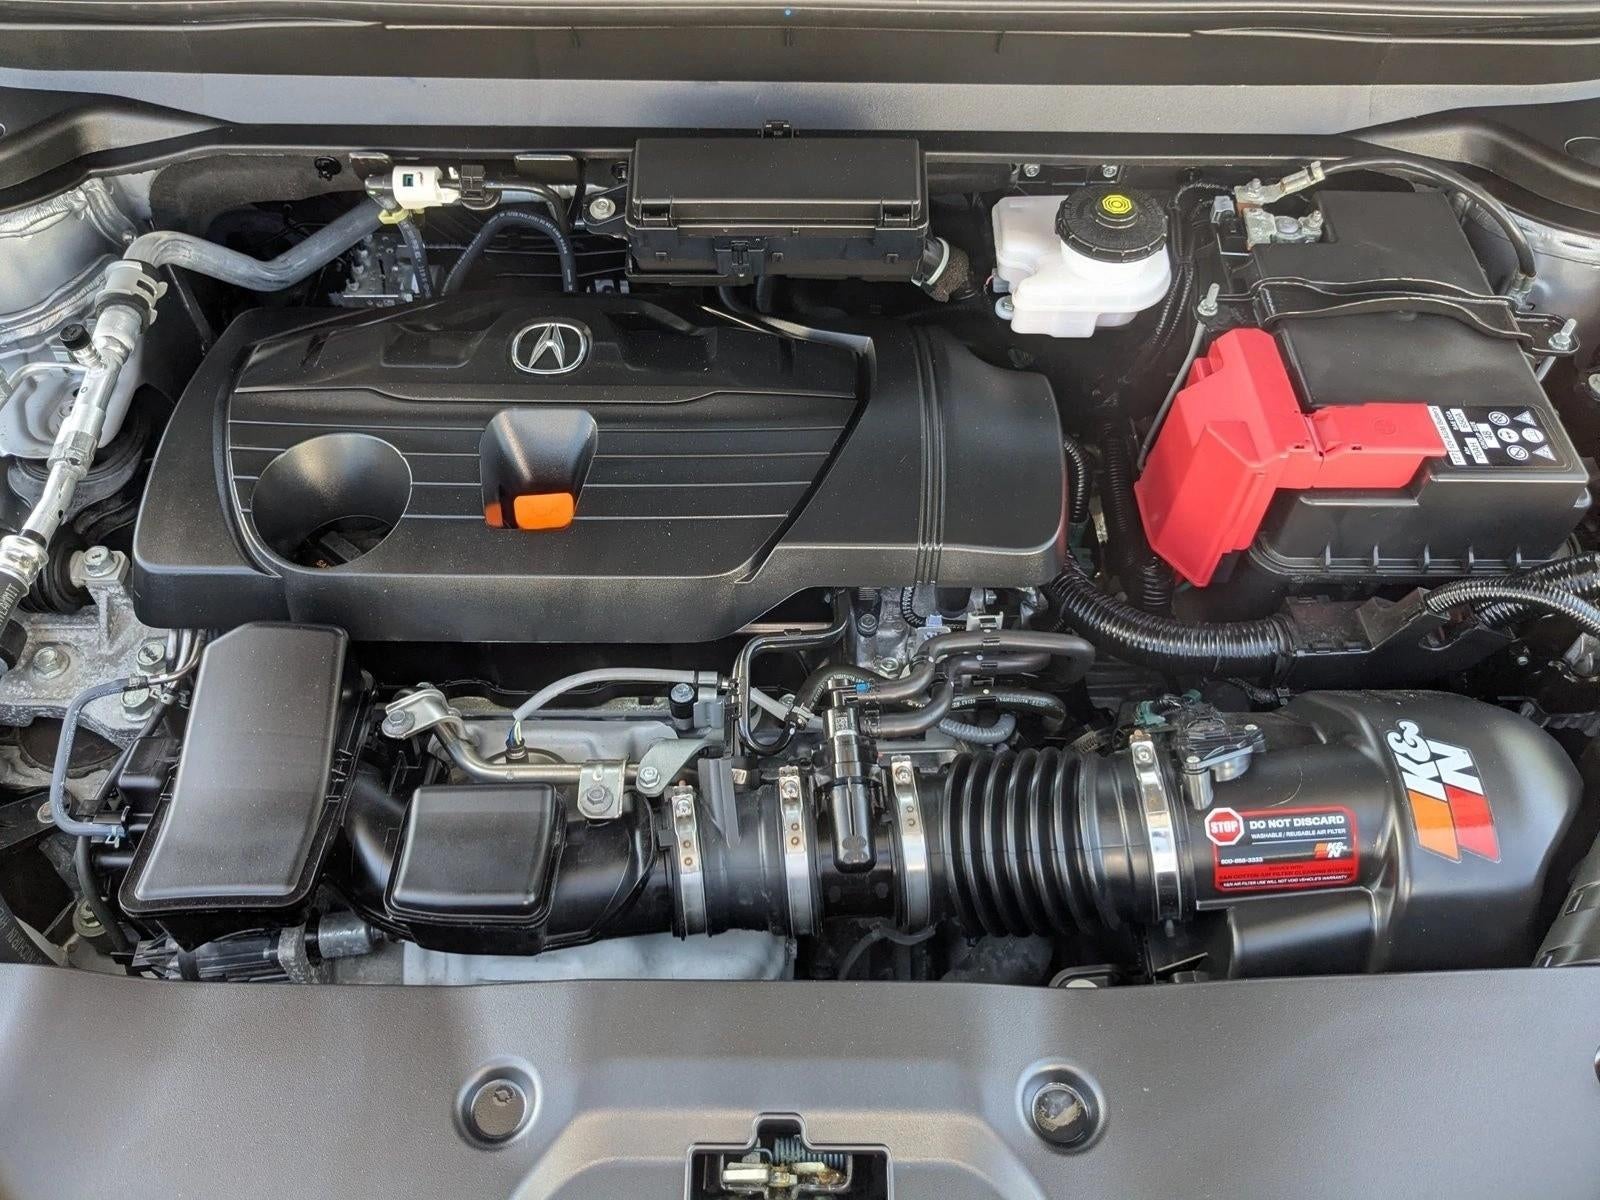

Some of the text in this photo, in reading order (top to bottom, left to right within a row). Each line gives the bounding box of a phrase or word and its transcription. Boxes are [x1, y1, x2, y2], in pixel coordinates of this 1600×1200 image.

[1387, 720, 1484, 802] K&N
[1211, 821, 1238, 834] STOP
[1249, 815, 1345, 829] DO NOT DISCARD
[1251, 831, 1282, 839] WASHABLE
[1286, 829, 1316, 837] REUSABLE
